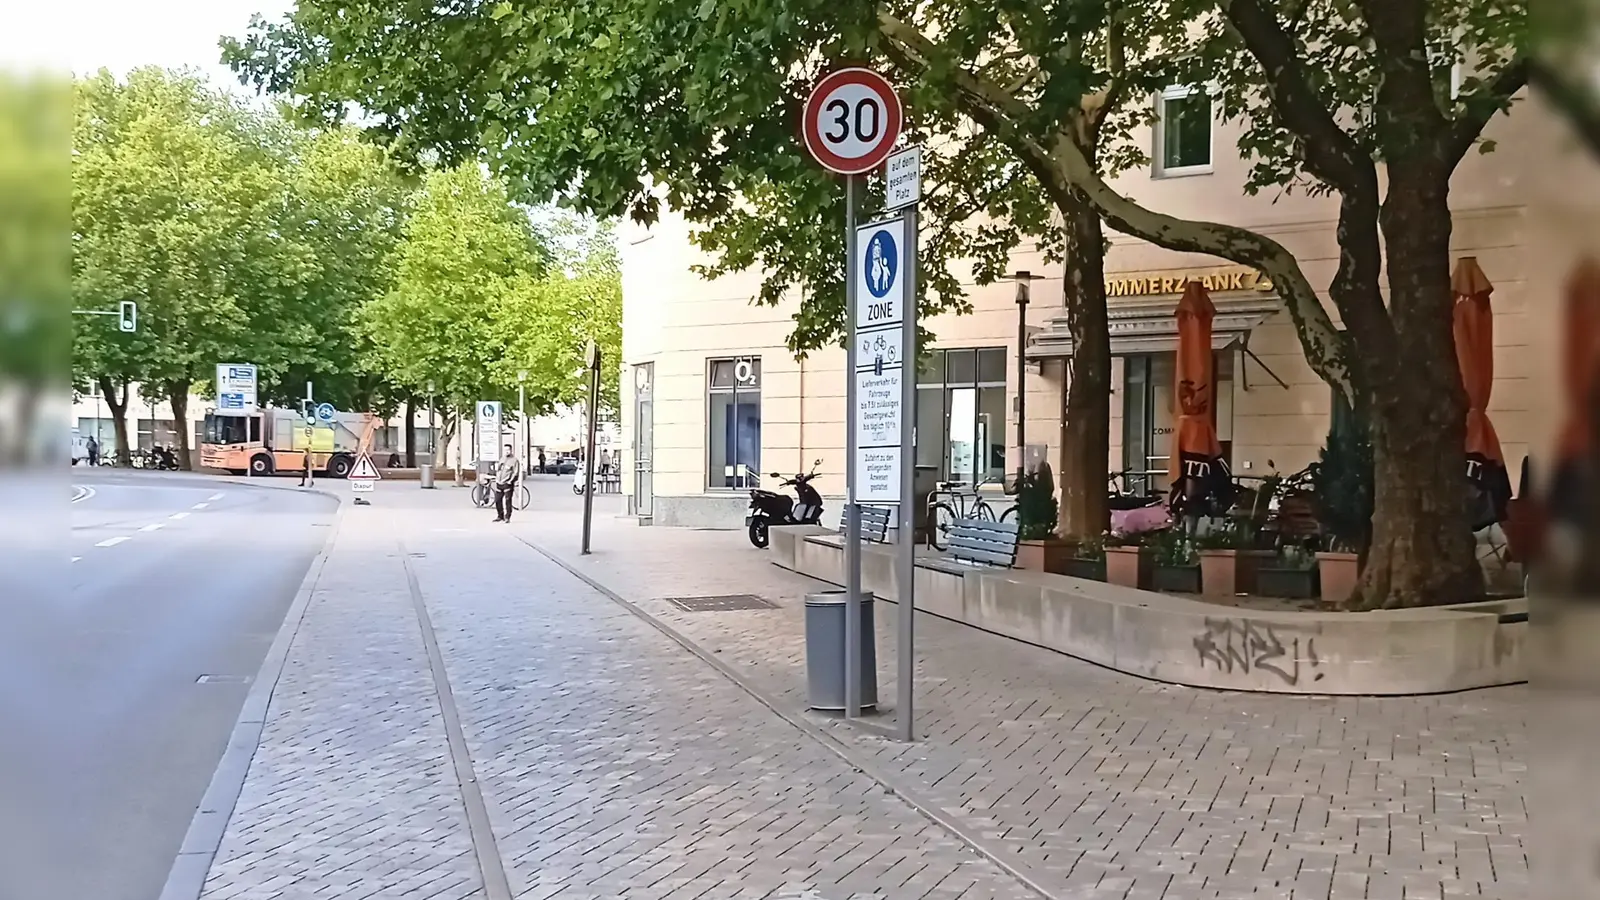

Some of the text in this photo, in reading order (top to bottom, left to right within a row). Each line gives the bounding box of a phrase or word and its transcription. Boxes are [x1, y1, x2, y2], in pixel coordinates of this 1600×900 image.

[825, 98, 879, 143] 30
[892, 156, 915, 172] auf dem
[889, 171, 917, 191] gesamten
[895, 188, 910, 201] Platz
[868, 301, 893, 321] ZONE
